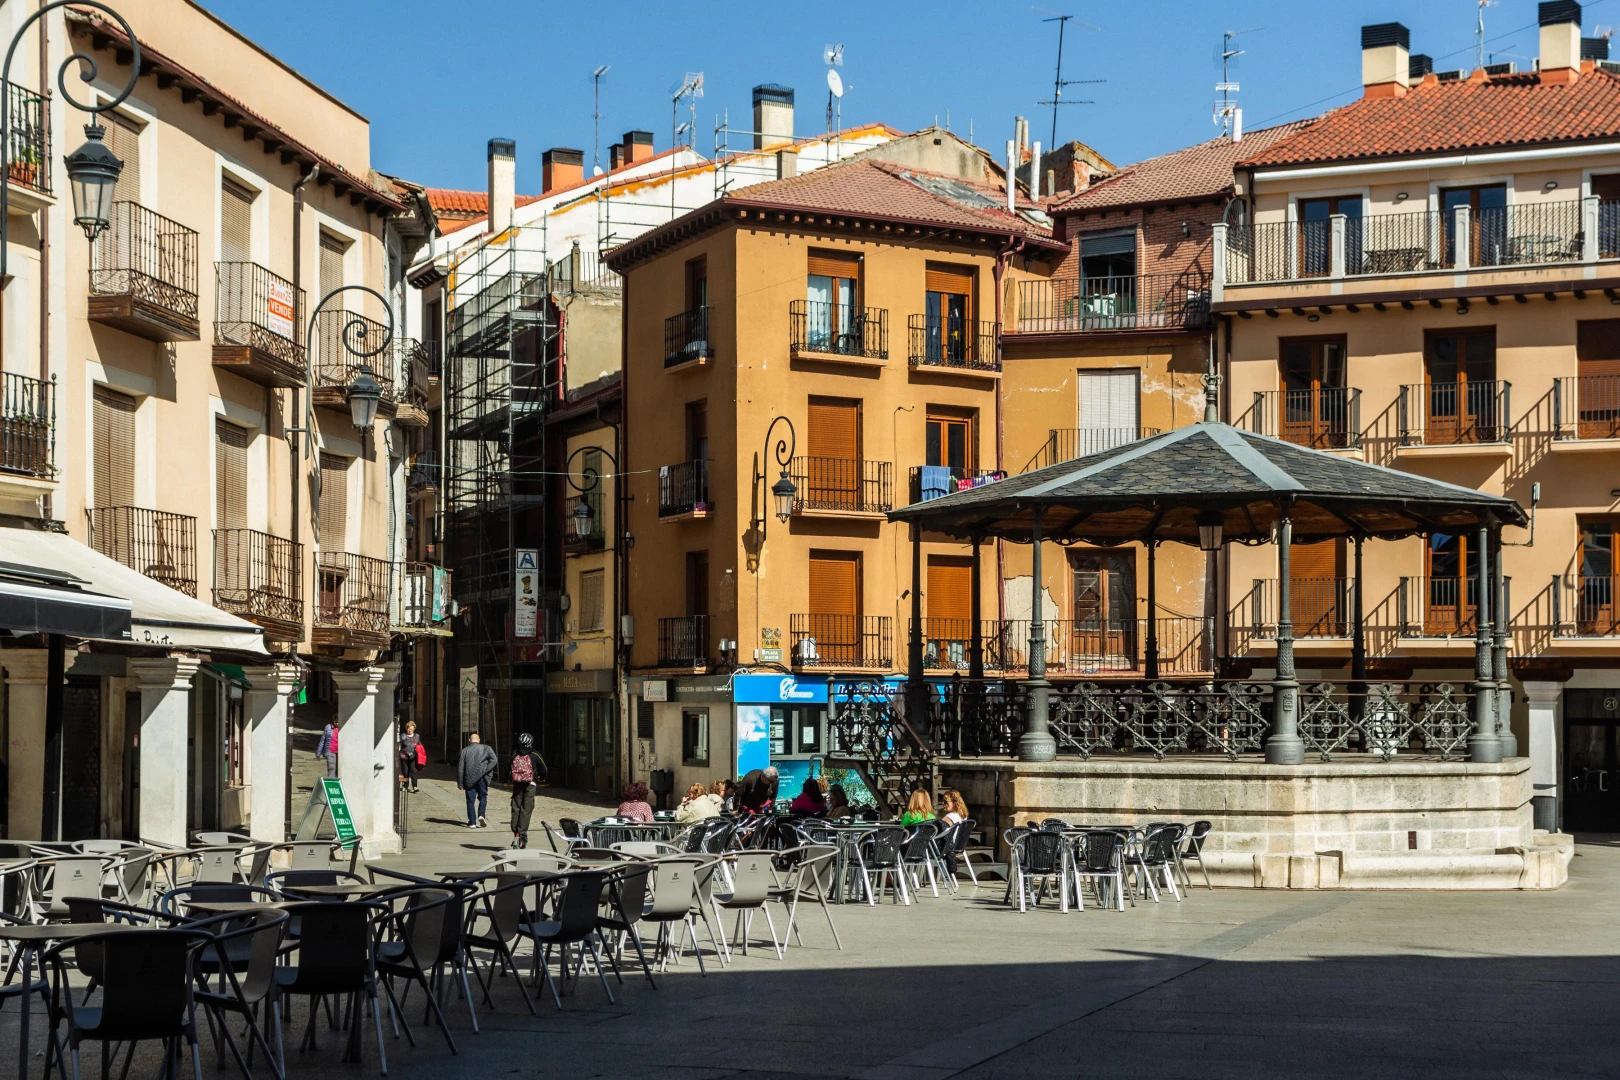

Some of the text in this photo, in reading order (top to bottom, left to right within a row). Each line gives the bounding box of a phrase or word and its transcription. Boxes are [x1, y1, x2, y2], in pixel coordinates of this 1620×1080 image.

[270, 300, 292, 319] VENDE
[519, 552, 536, 568] A
[1606, 700, 1615, 708] 21
